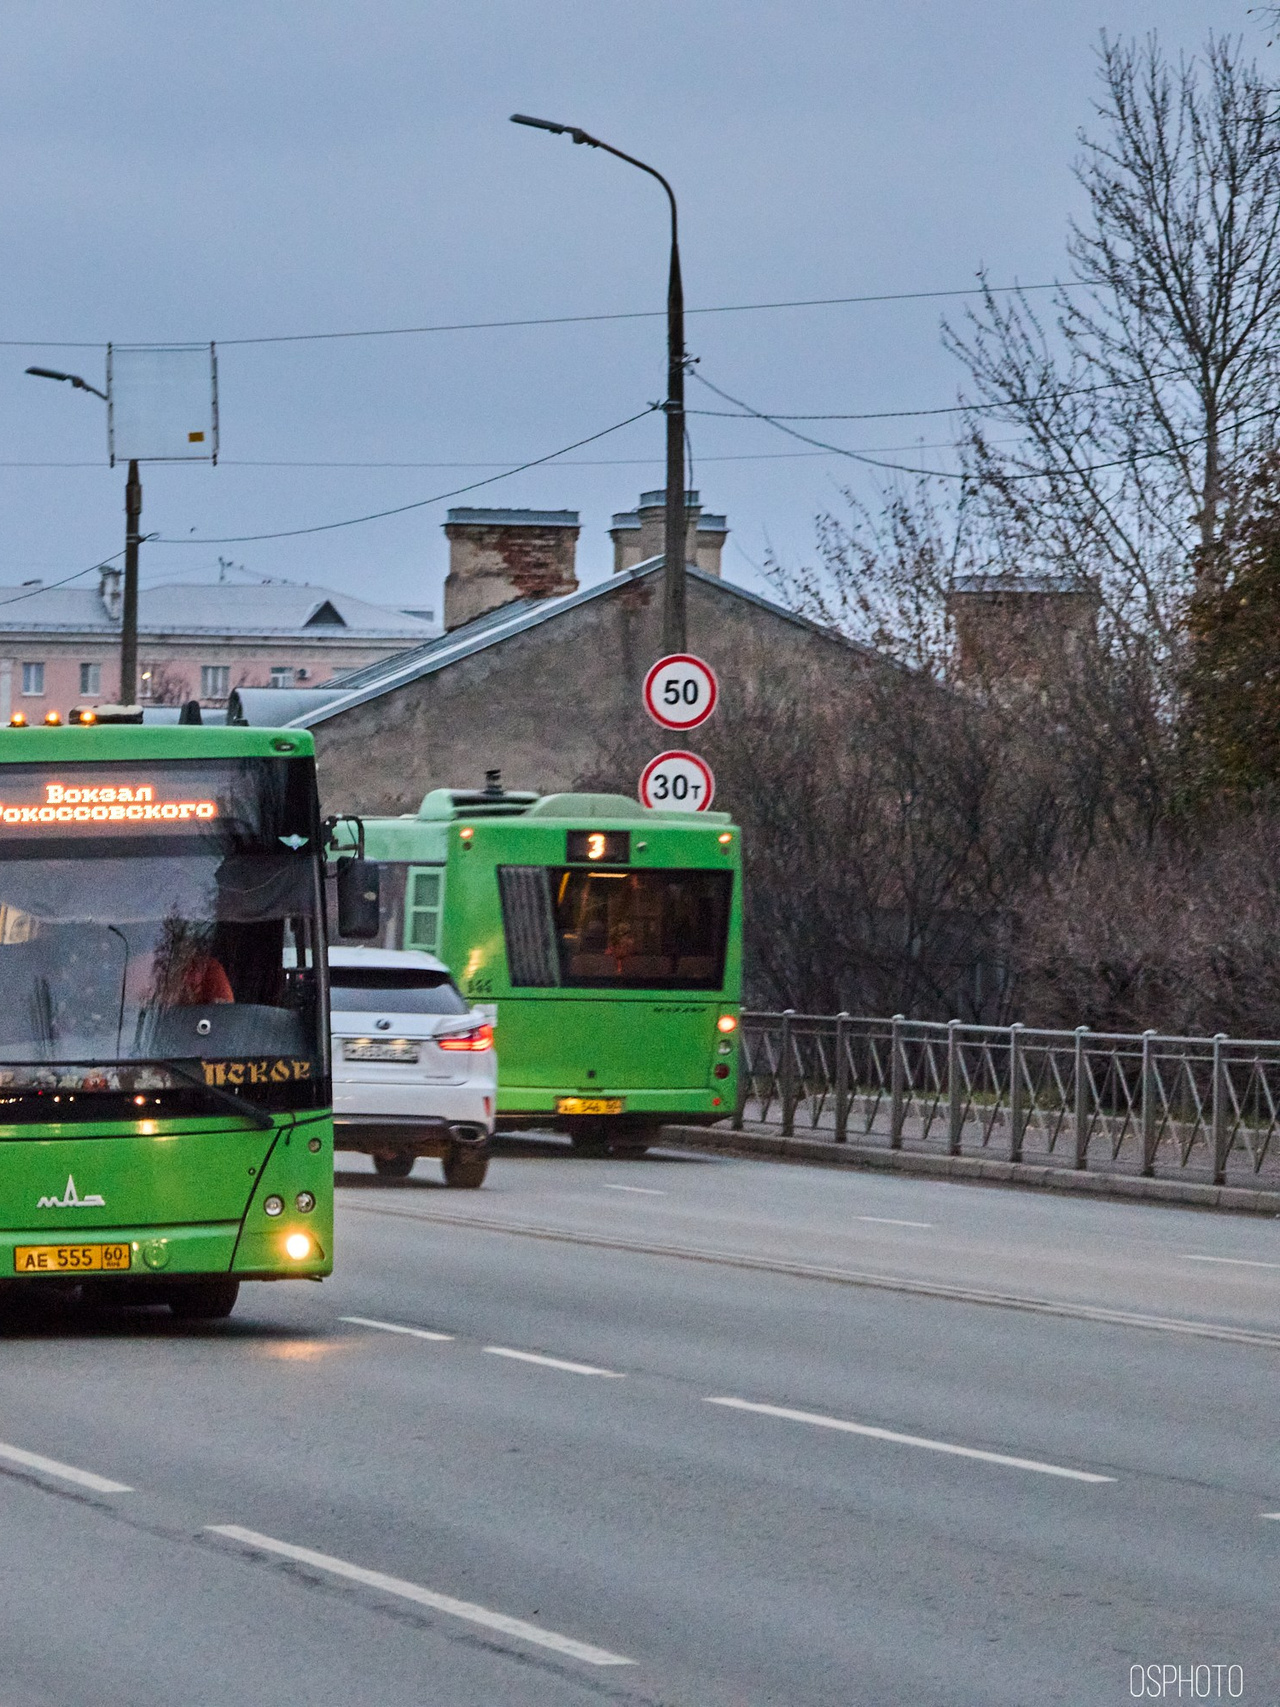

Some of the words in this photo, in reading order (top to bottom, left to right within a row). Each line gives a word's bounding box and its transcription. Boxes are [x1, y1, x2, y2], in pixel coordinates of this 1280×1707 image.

[664, 679, 698, 705] 50
[45, 784, 153, 804] Вокзал
[588, 834, 606, 858] 3
[57, 1249, 93, 1266] 555
[104, 1247, 122, 1260] 60
